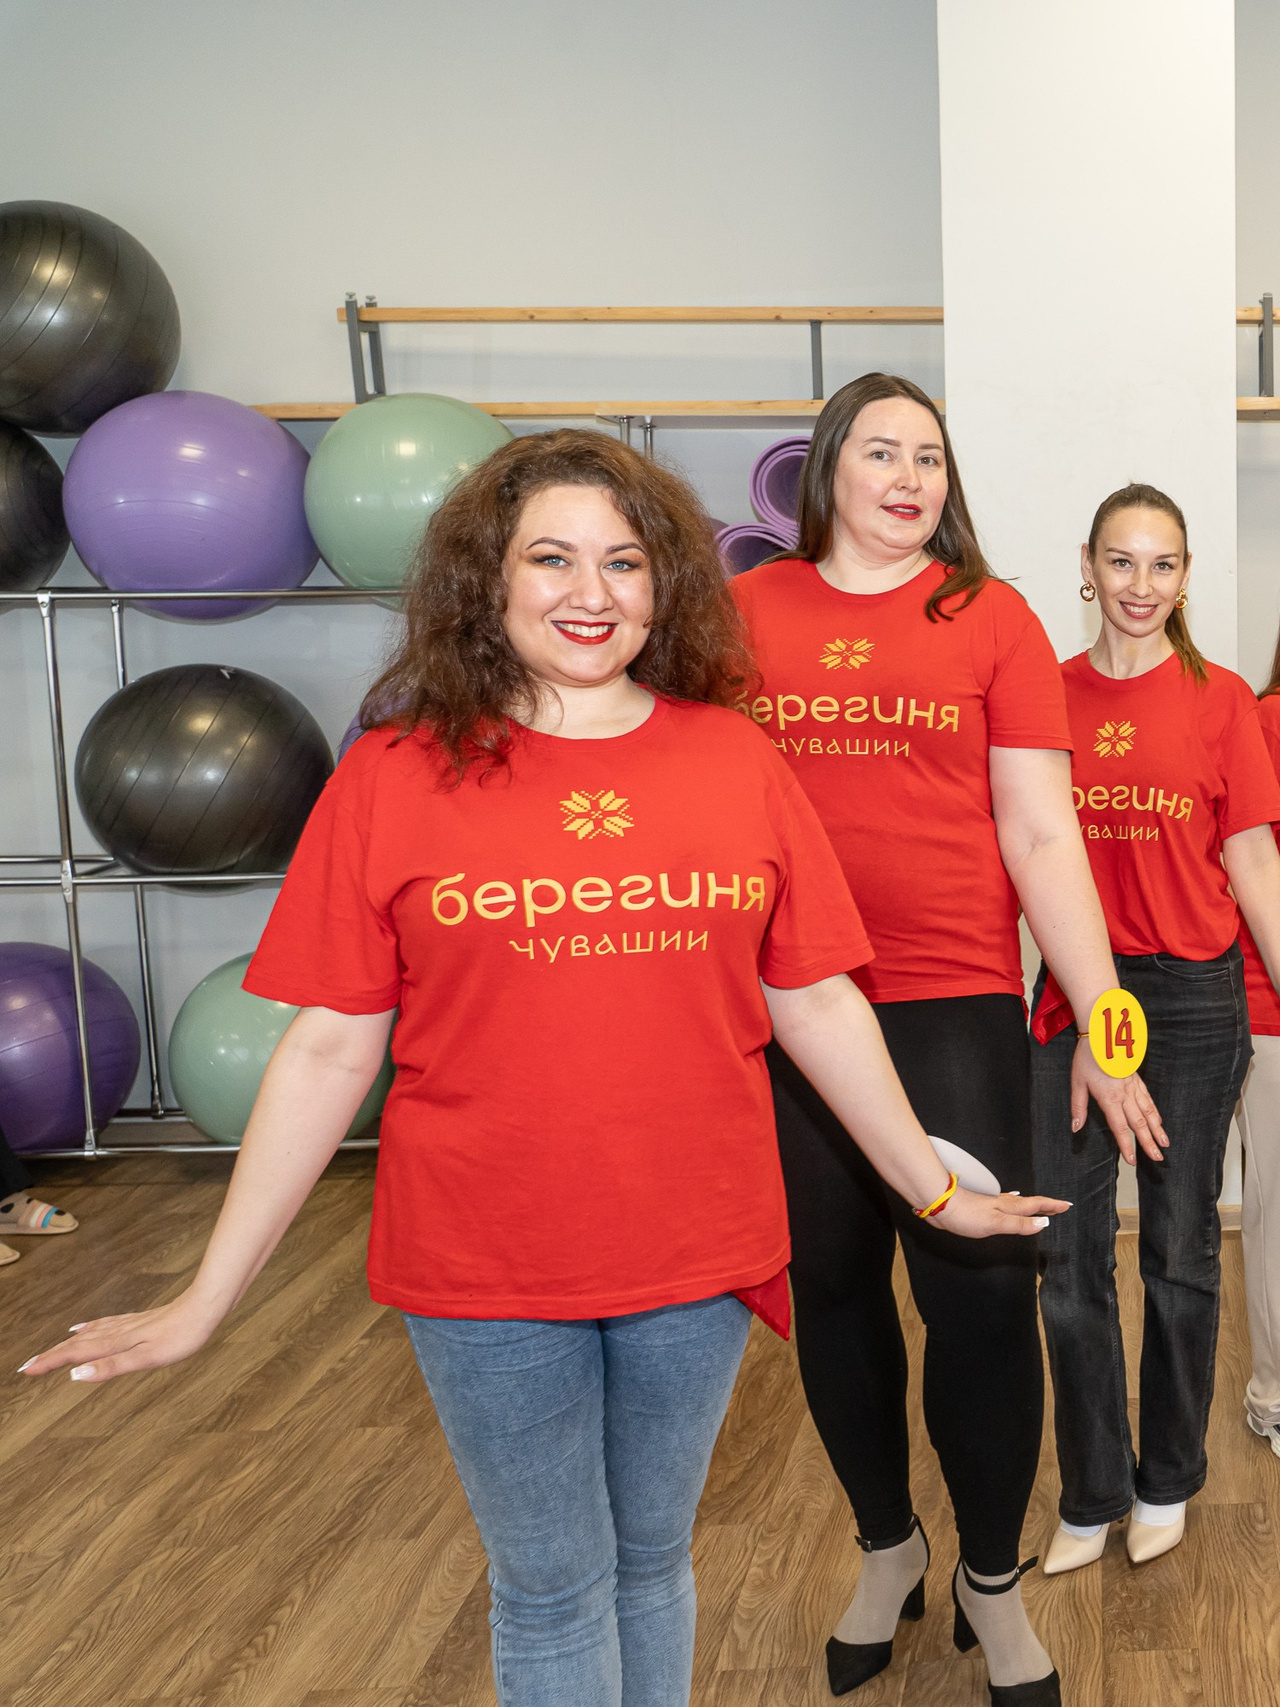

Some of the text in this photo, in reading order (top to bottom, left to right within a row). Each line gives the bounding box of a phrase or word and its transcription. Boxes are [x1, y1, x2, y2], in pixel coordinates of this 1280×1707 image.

[770, 737, 910, 757] чувашии
[1072, 785, 1194, 823] егиня
[1081, 823, 1160, 842] вашии
[432, 871, 766, 928] берегиня
[508, 930, 709, 963] чувашии
[1102, 1007, 1135, 1060] 14
